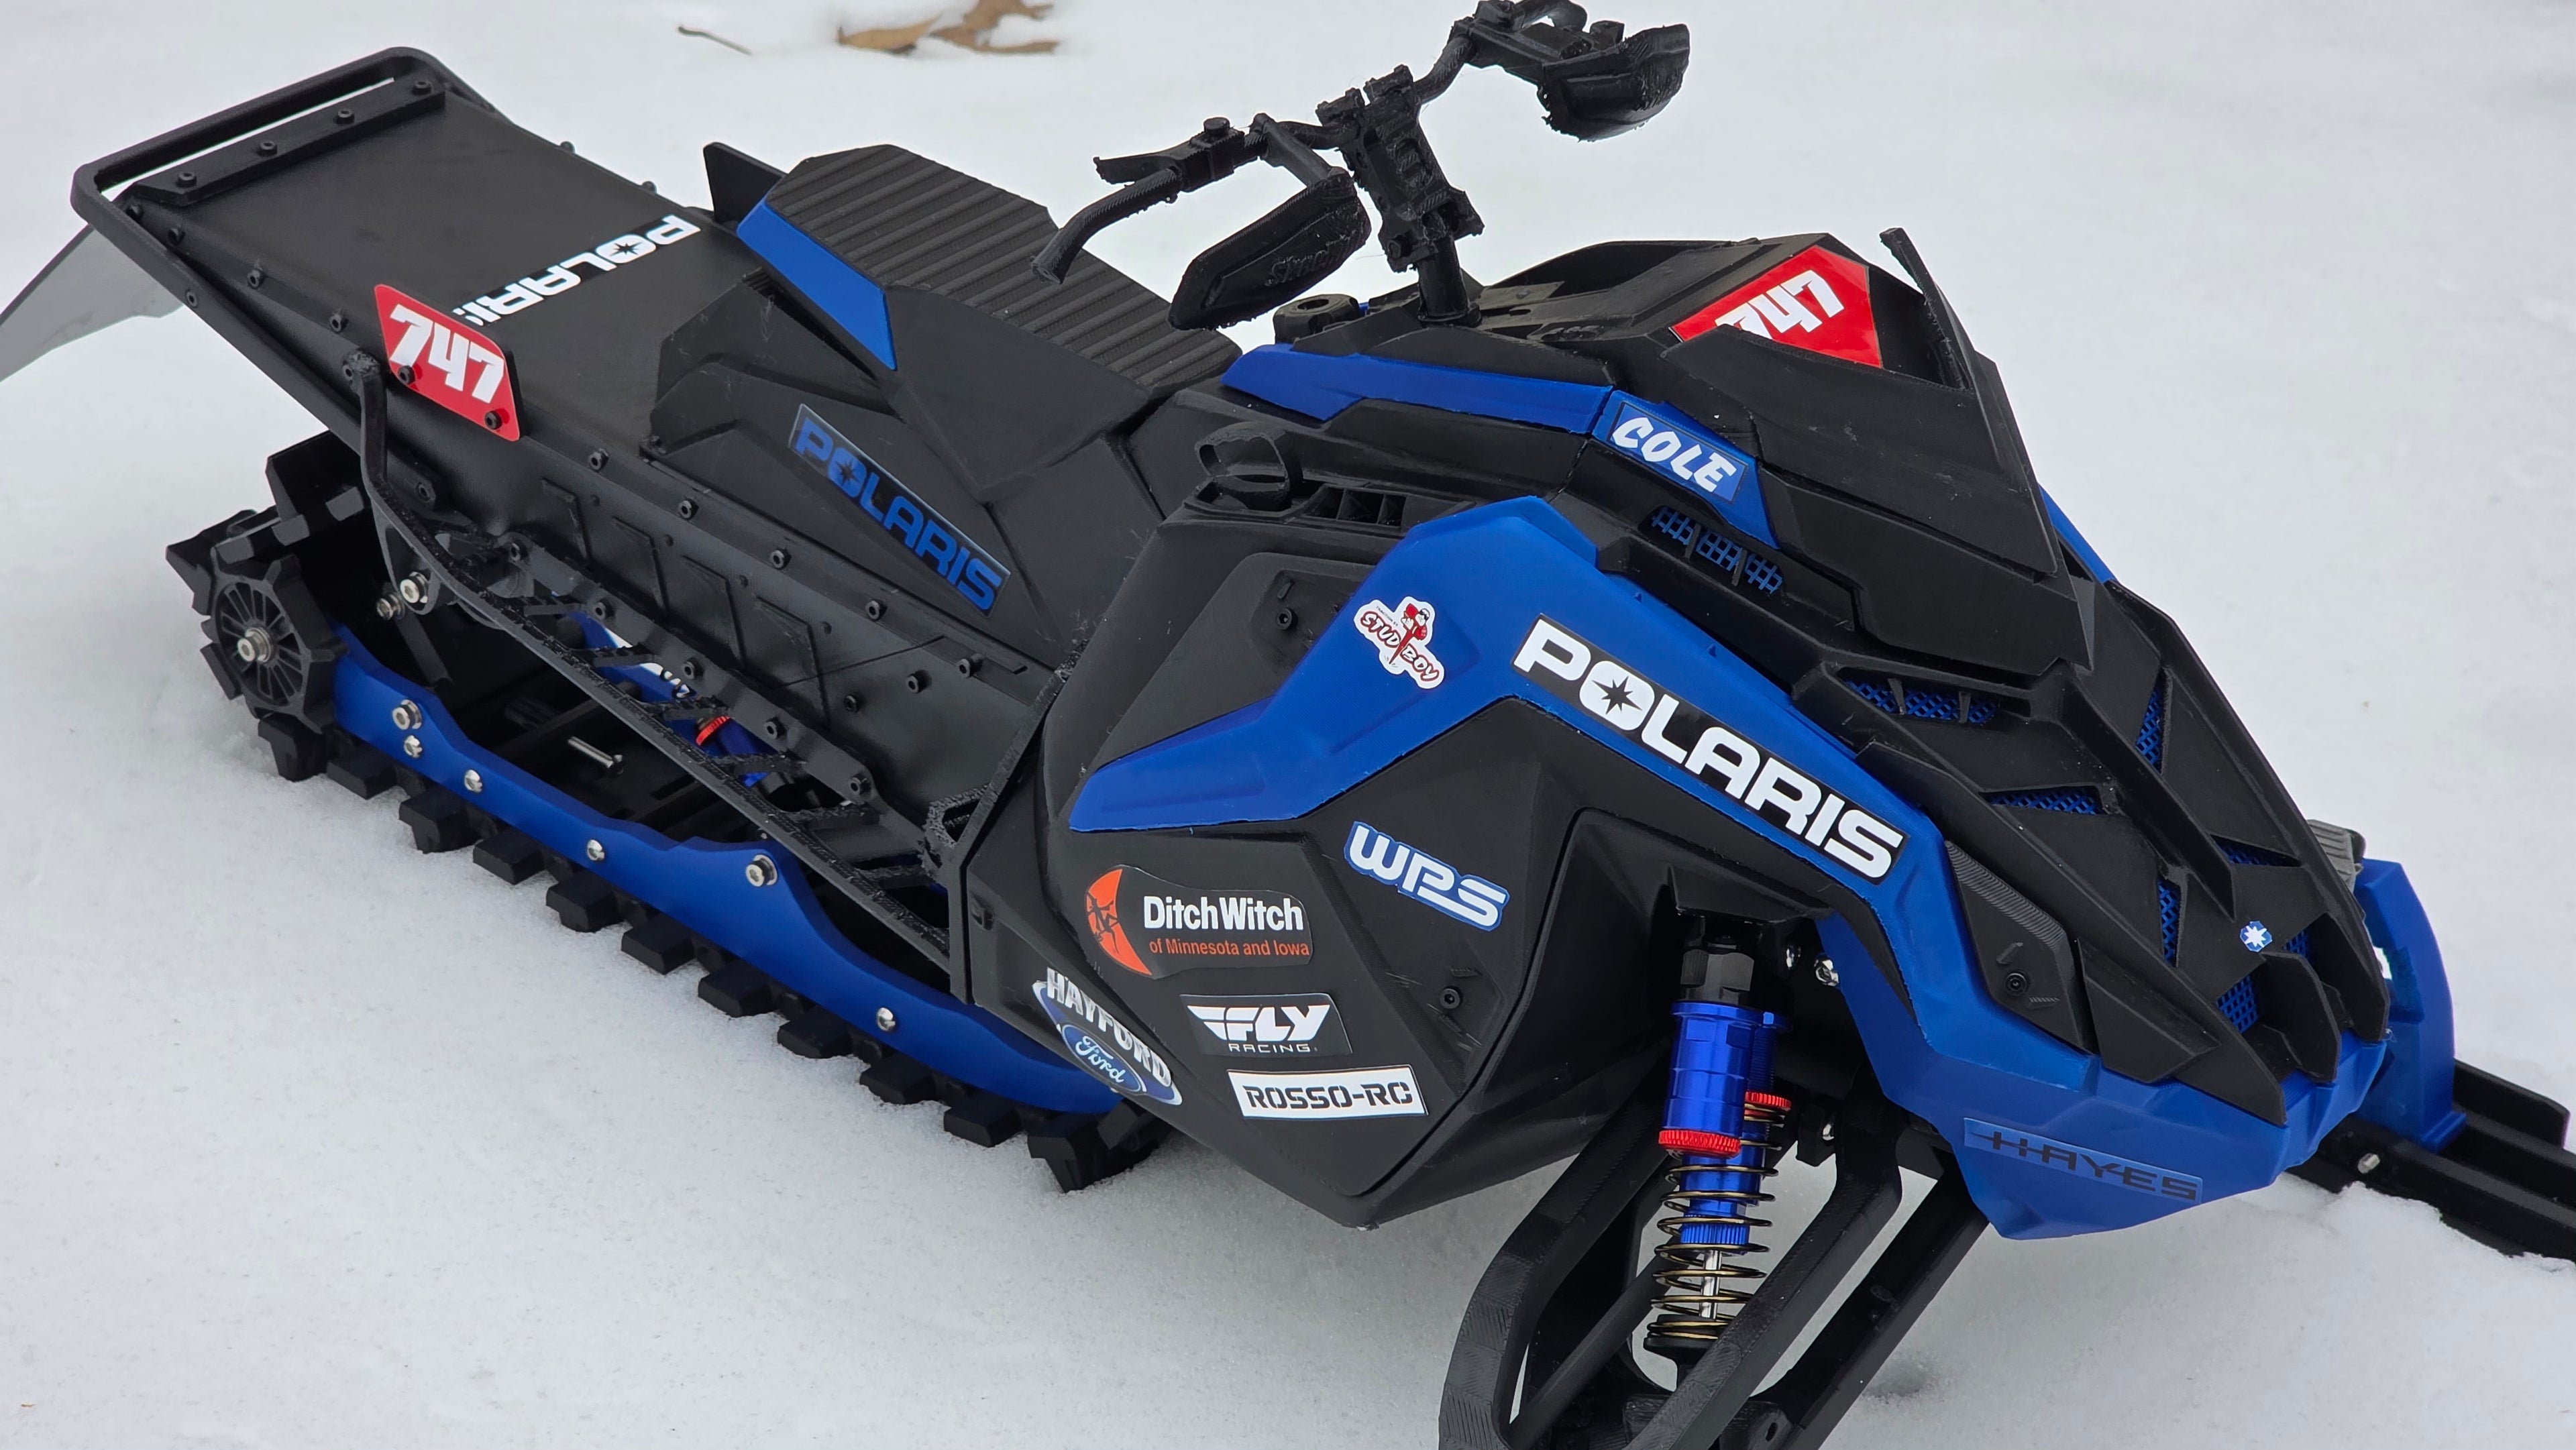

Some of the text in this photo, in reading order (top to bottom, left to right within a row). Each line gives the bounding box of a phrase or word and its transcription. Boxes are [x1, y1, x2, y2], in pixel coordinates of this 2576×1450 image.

[1714, 270, 1845, 339] 747
[390, 304, 504, 403] 747
[1612, 417, 1737, 493] COLE
[796, 417, 1002, 610] POLARIS
[1360, 611, 1440, 682] STUD BOY
[1514, 618, 1904, 880] POLARIS
[1349, 826, 1507, 927] WPS
[1149, 938, 1310, 956] of Minnesota and Iowa
[1046, 967, 1172, 1088] HAYFORD
[1187, 1004, 1330, 1042] FLY
[1228, 1043, 1311, 1053] RACING
[1075, 1036, 1126, 1083] Ford
[1242, 1081, 1413, 1109] ROSSO-RC
[1974, 1131, 2198, 1202] HAYES
